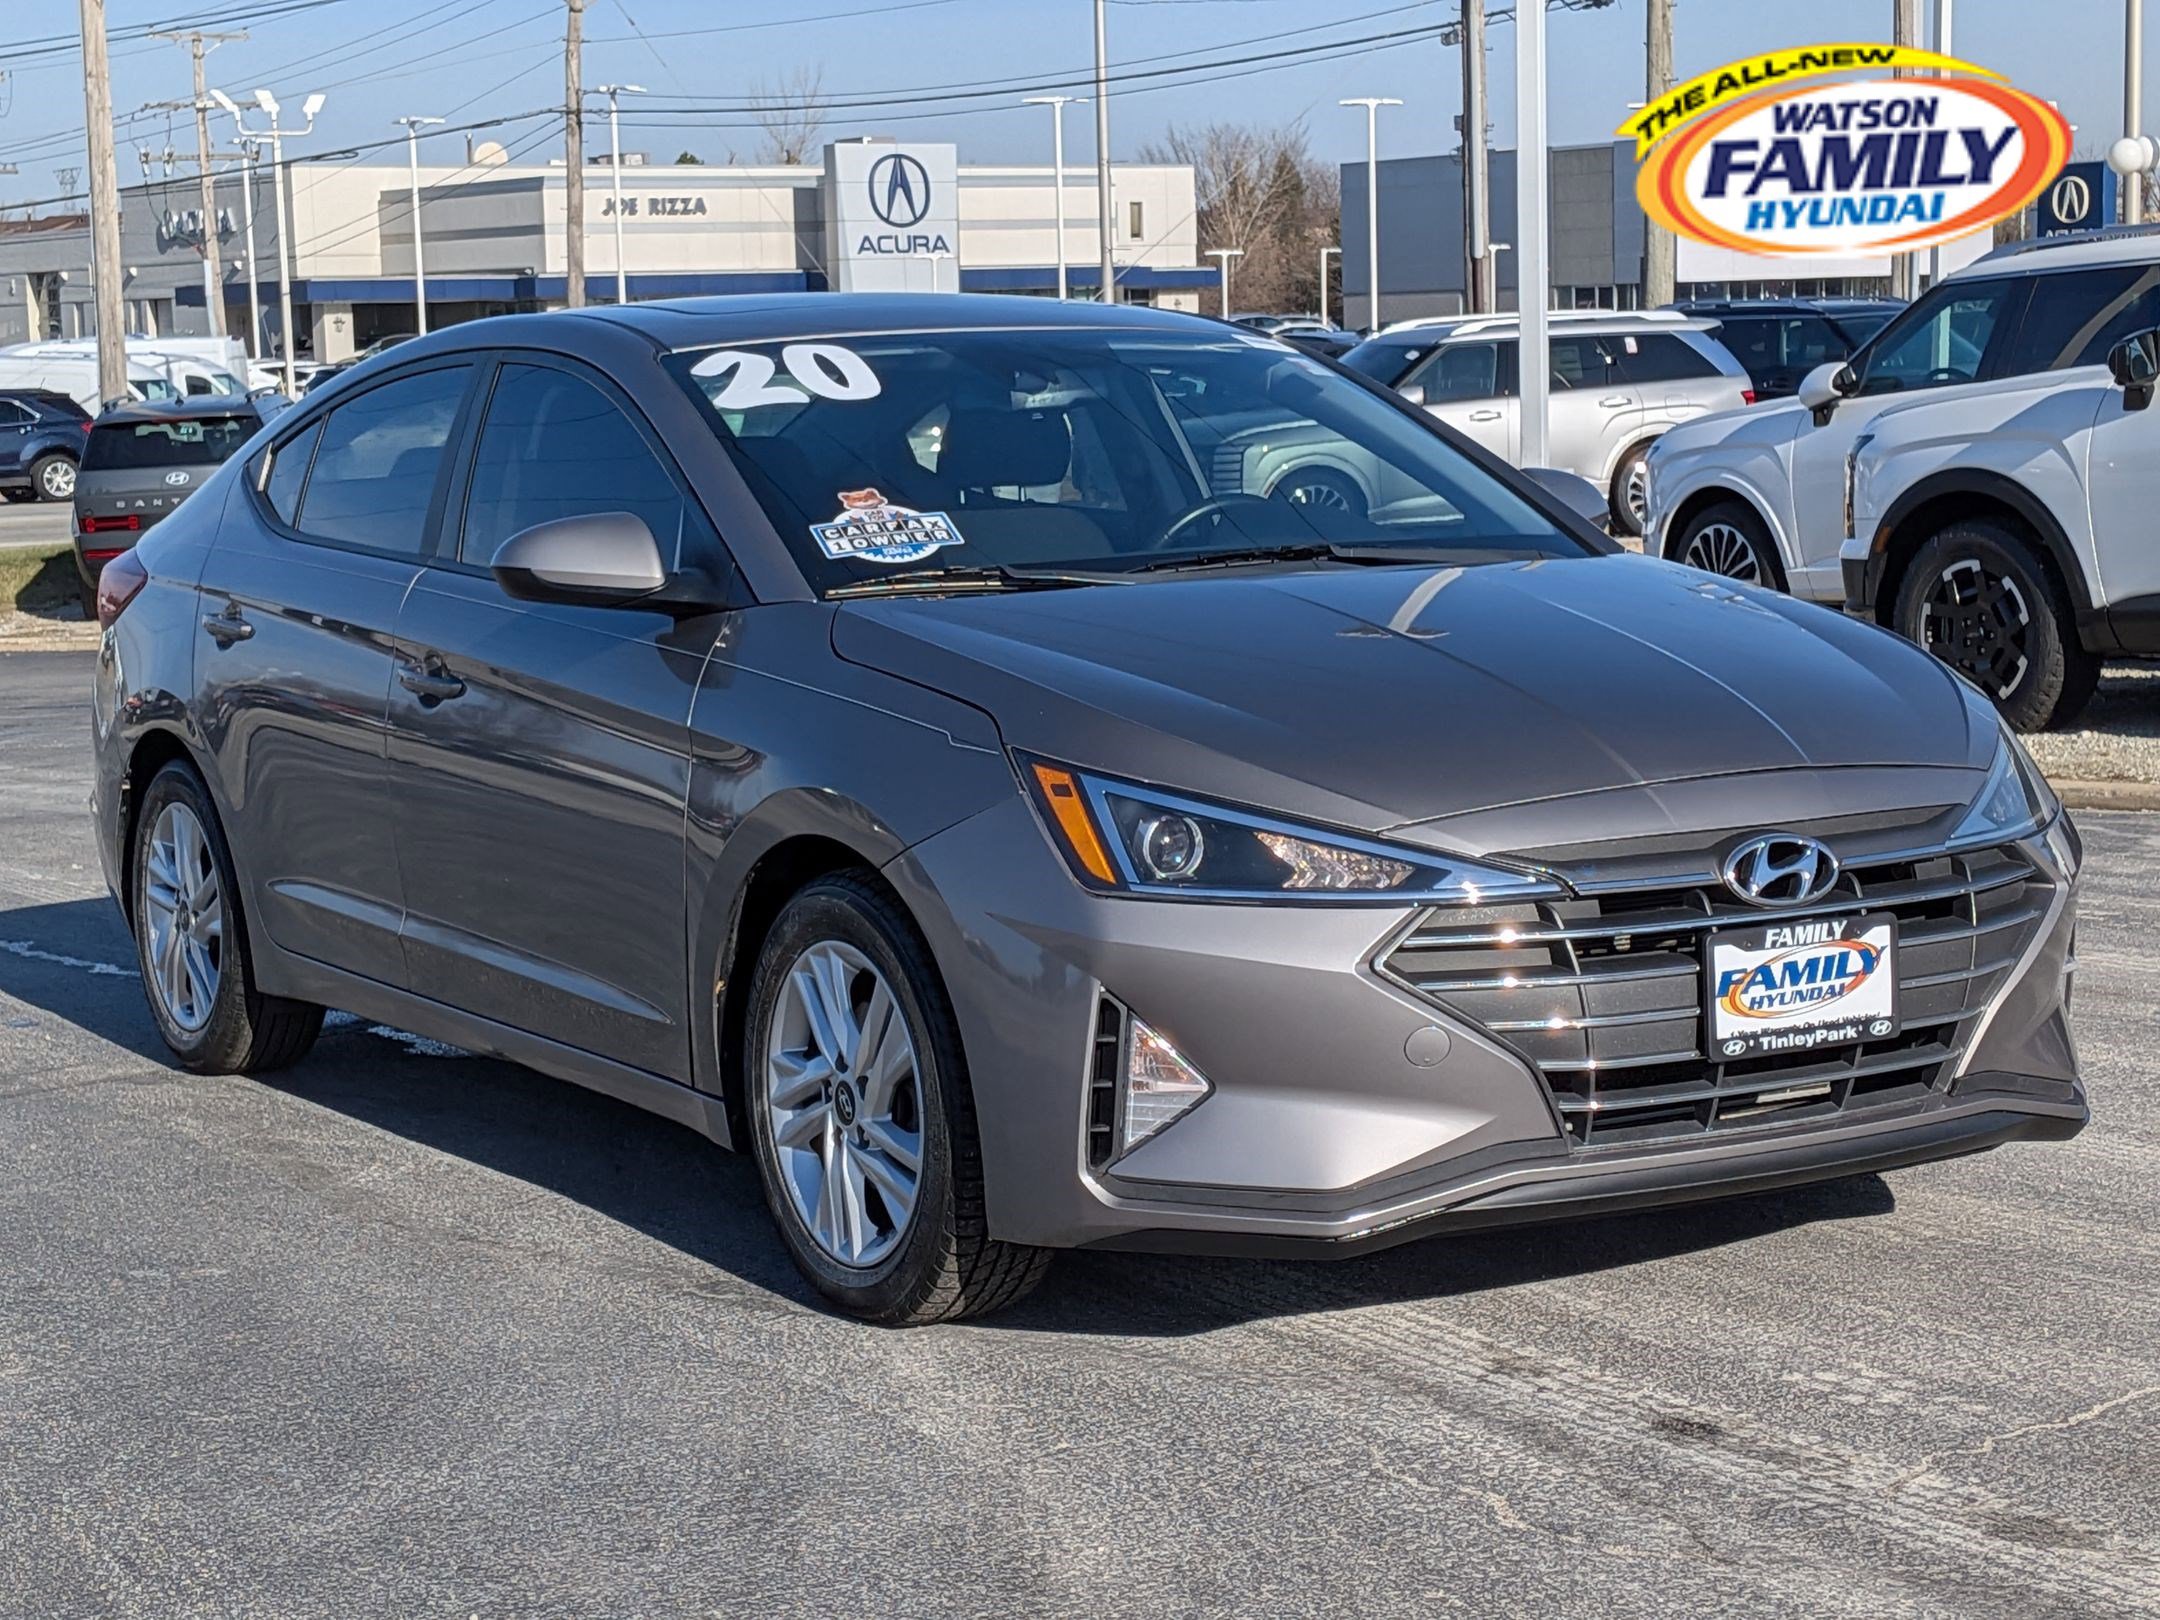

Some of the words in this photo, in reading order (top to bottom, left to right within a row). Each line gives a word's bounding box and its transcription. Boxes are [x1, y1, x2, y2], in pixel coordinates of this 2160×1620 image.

[601, 197, 639, 216] JOE
[647, 197, 707, 216] RIZZA
[857, 235, 951, 255] ACURA
[690, 344, 881, 409] 20
[824, 519, 942, 538] CARFAX
[1764, 920, 1848, 948] FAMILY
[1716, 945, 1888, 998] FAMILY
[1748, 983, 1847, 1011] HYUNDAI
